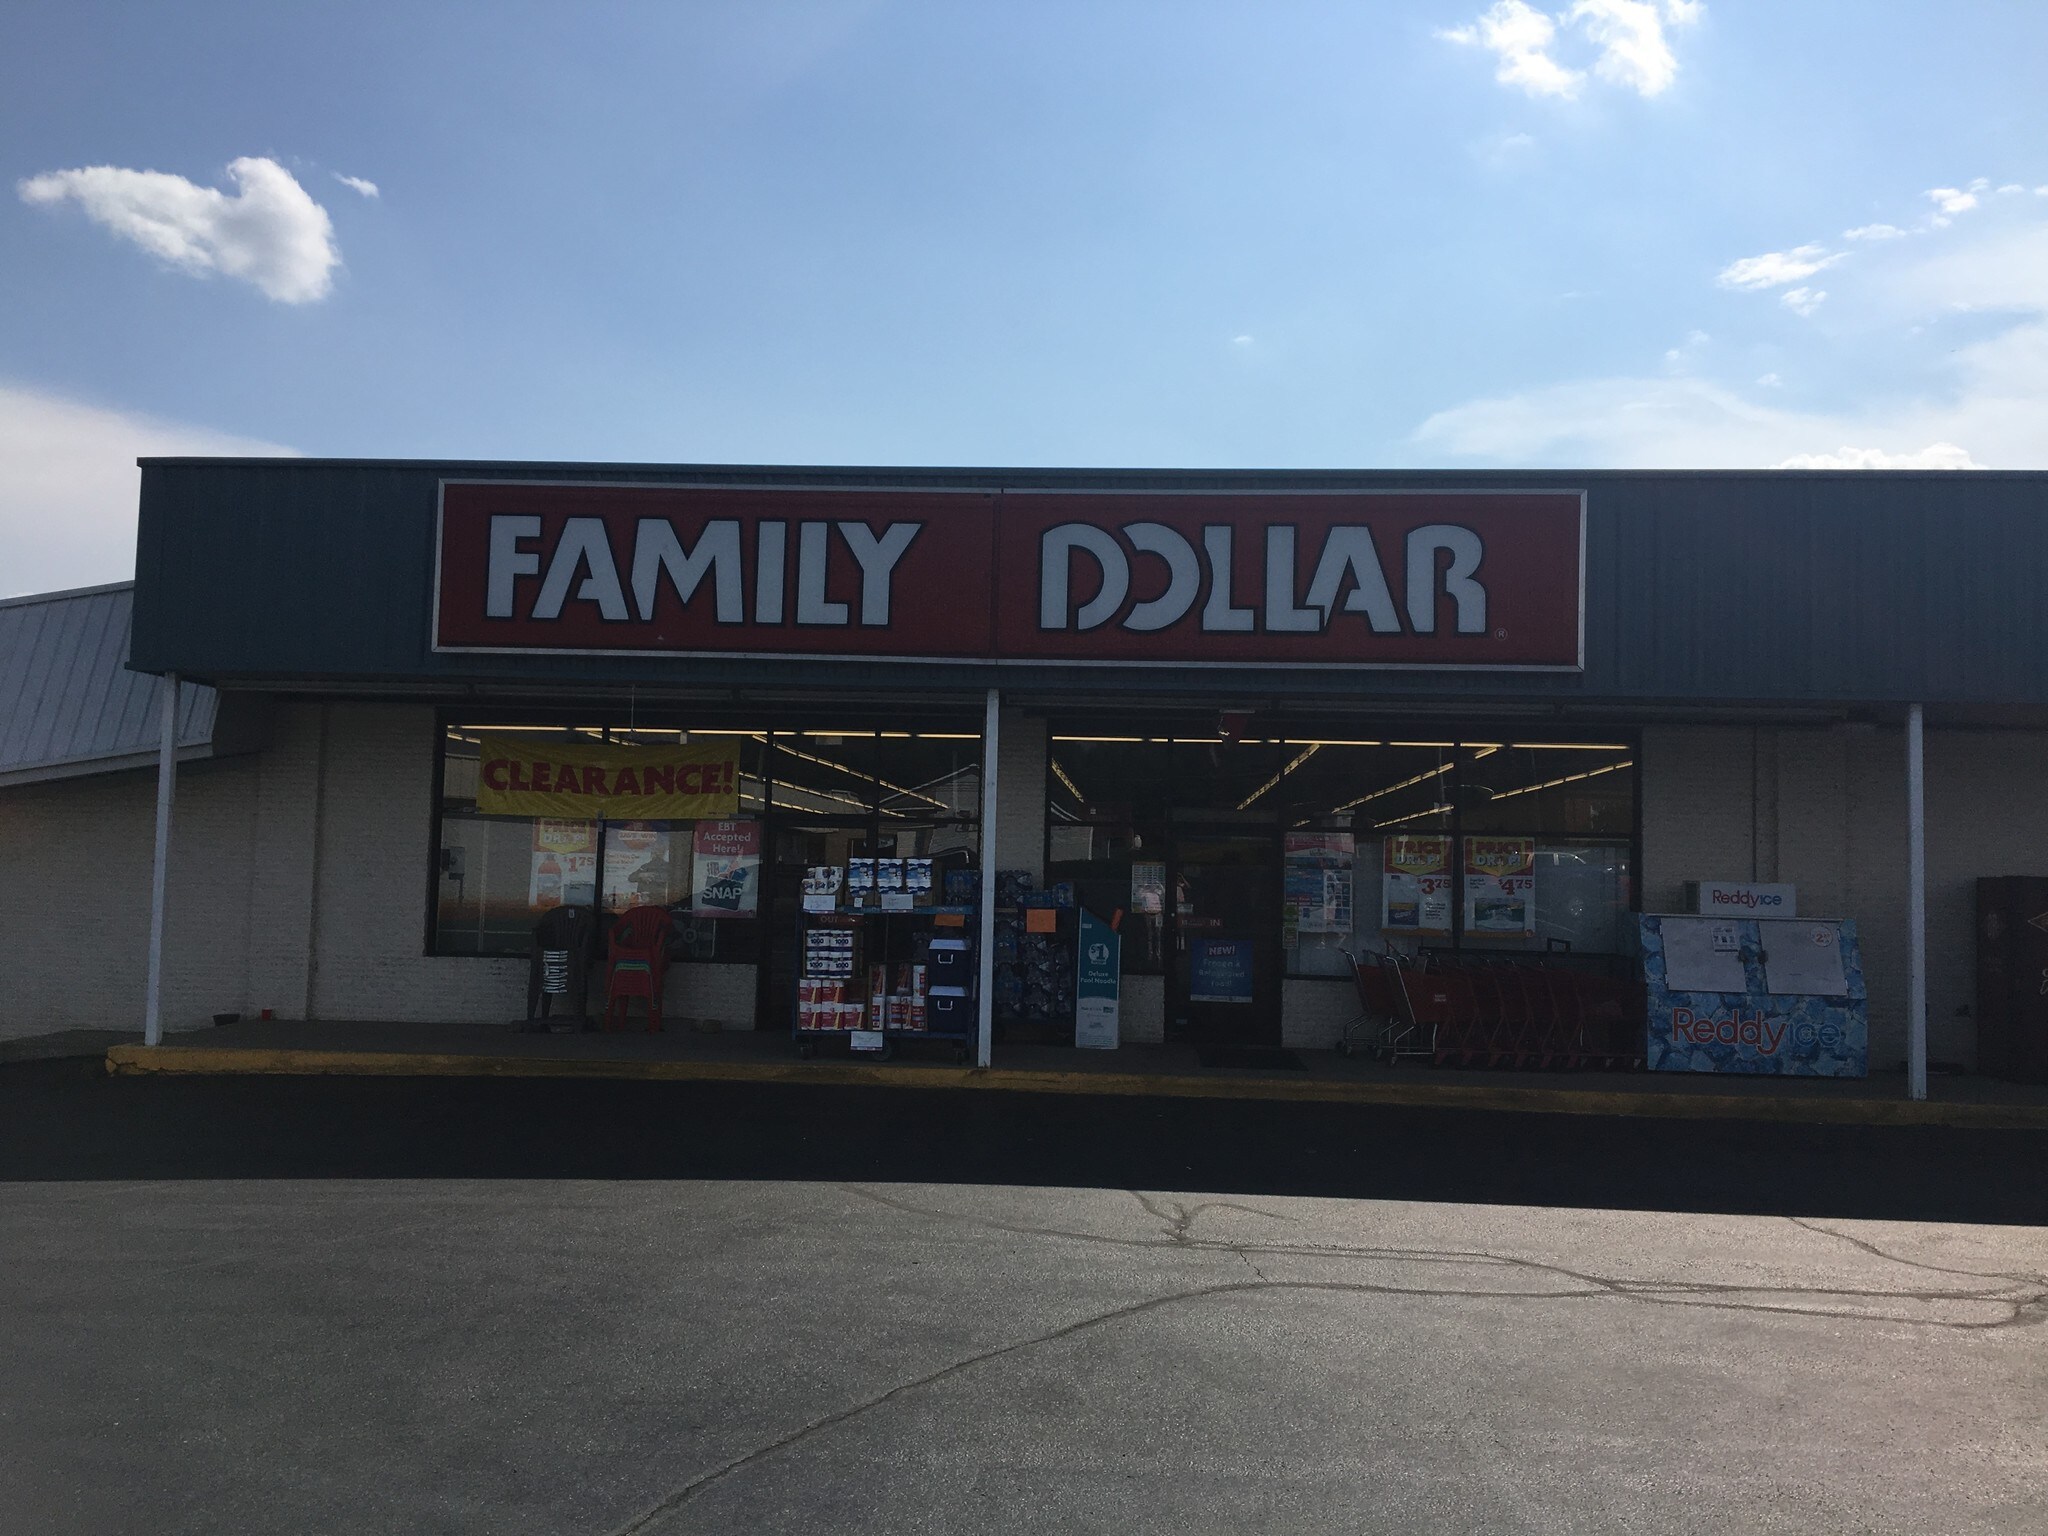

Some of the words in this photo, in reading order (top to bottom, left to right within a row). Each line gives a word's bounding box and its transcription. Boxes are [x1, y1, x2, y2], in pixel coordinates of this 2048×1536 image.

[486, 514, 923, 626] FAMILY
[1039, 521, 1487, 633] DOLLAR
[483, 758, 735, 796] CLEARANCE!
[718, 822, 737, 831] EBT
[703, 832, 752, 843] Accepted
[712, 844, 741, 853] Here!
[703, 886, 742, 899] SNAP
[1208, 945, 1236, 956] NEW!
